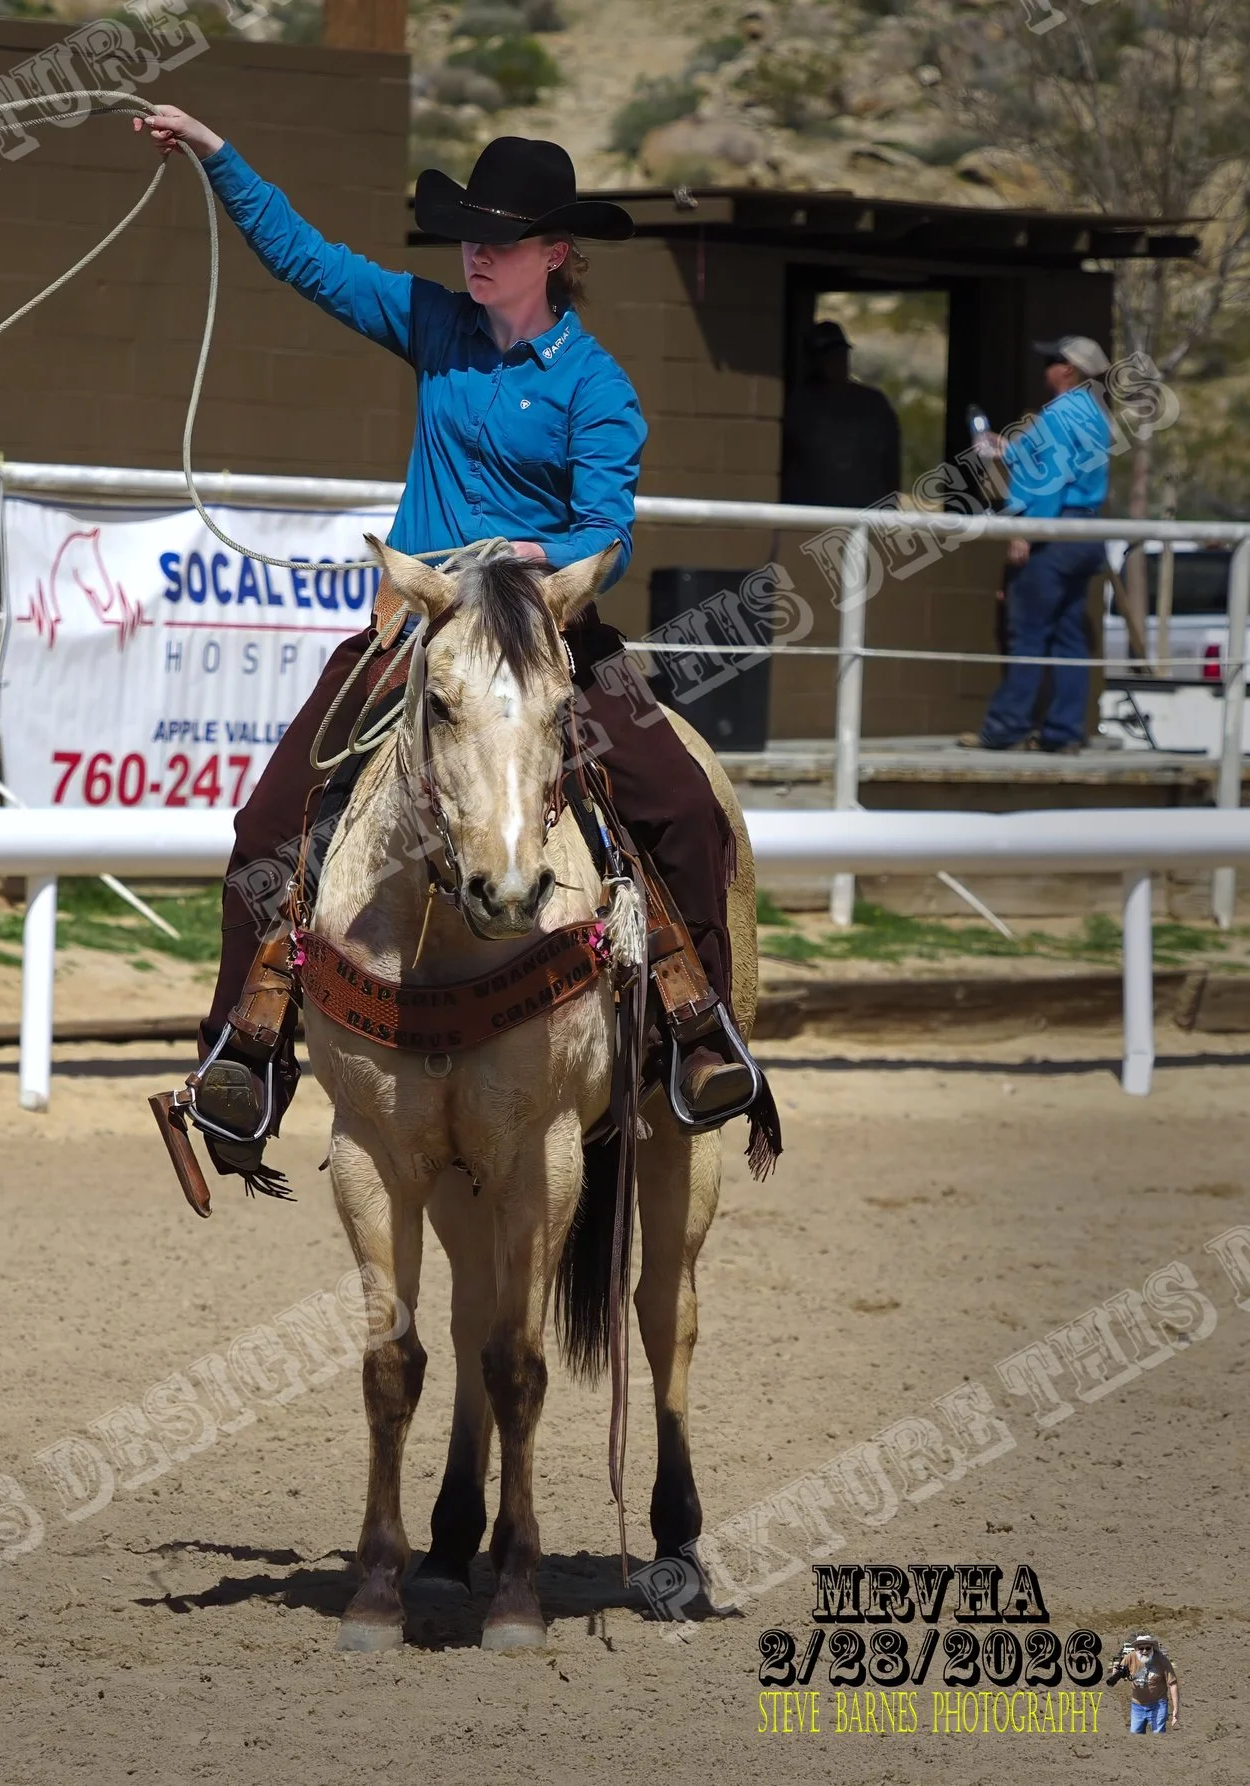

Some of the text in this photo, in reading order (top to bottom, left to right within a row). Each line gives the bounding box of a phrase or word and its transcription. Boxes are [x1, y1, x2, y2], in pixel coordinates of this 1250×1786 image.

[159, 551, 285, 606] SOCAL
[151, 720, 219, 743] APPLE
[53, 752, 257, 808] 760-247
